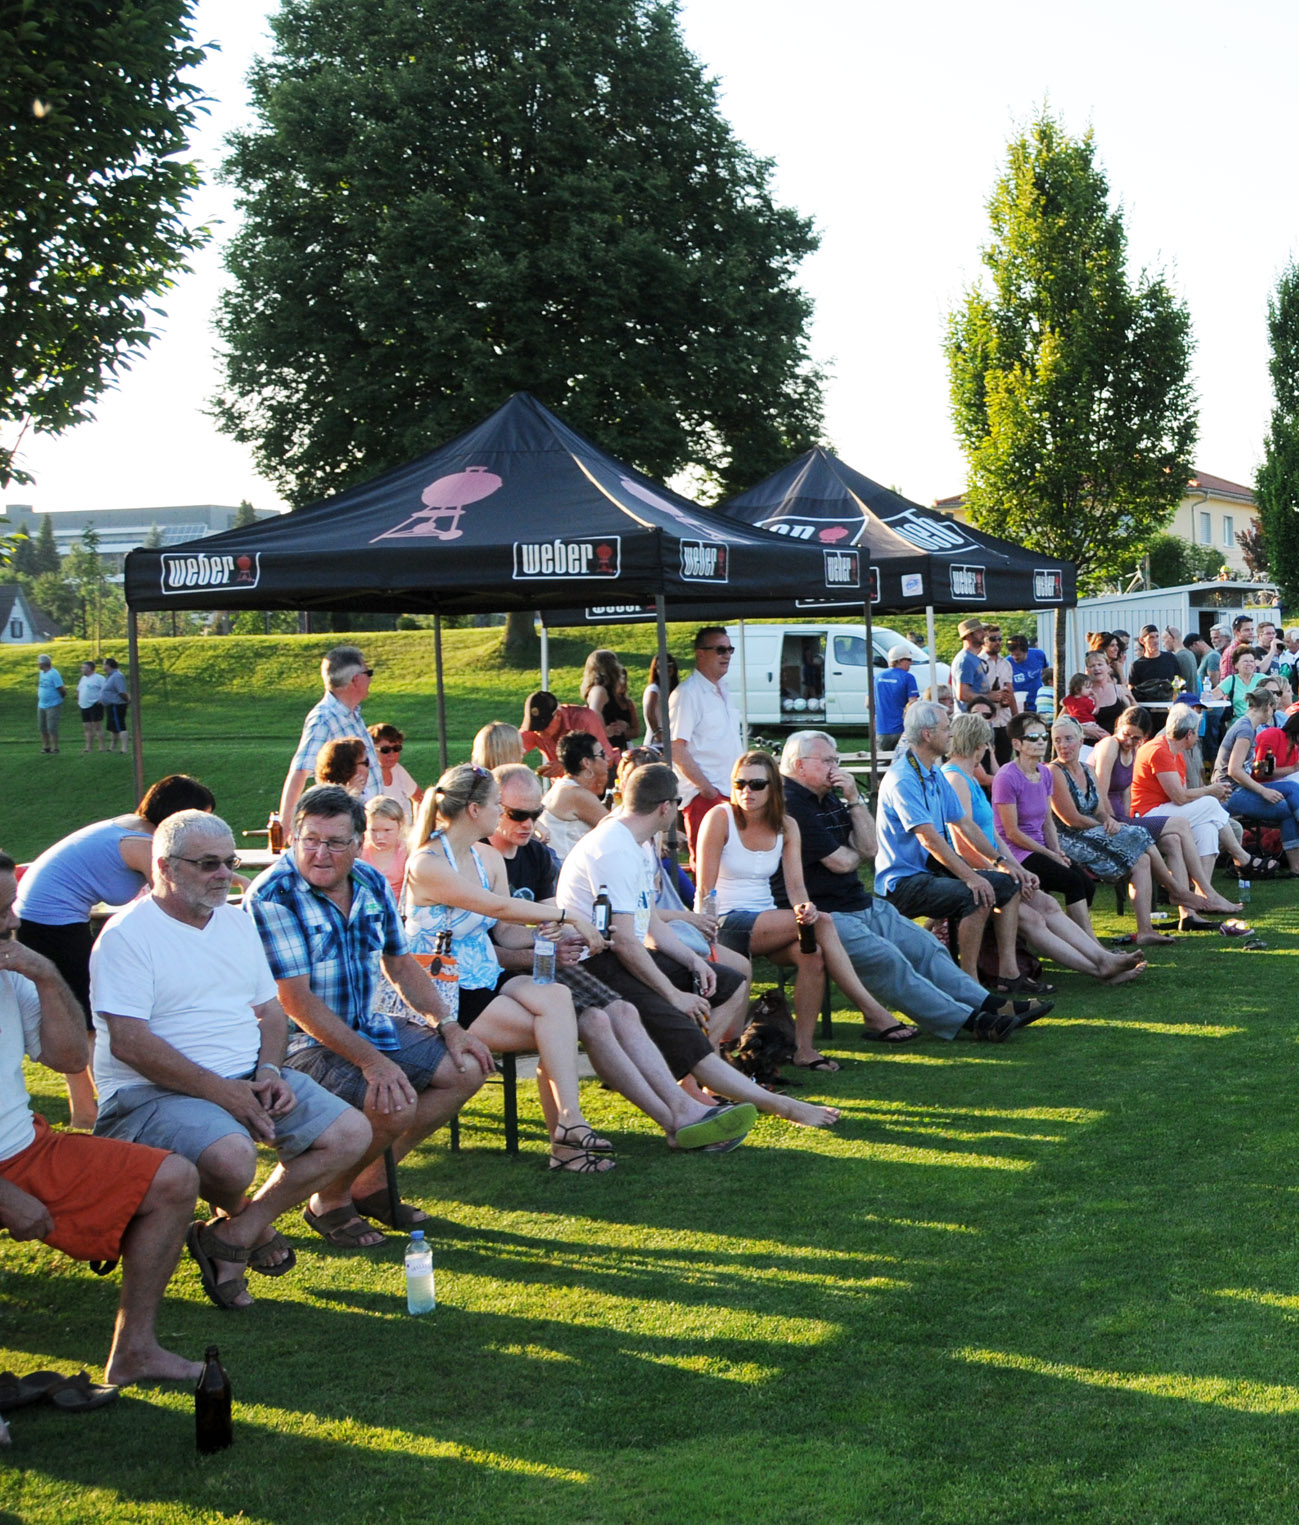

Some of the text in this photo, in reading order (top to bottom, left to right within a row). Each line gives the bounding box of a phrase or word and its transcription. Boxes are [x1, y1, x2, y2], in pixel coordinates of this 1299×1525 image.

[167, 553, 235, 587] weber
[521, 539, 594, 574] weber
[684, 541, 717, 576] weber
[827, 551, 852, 582] weber
[952, 566, 976, 595] weber
[1035, 570, 1055, 597] weber
